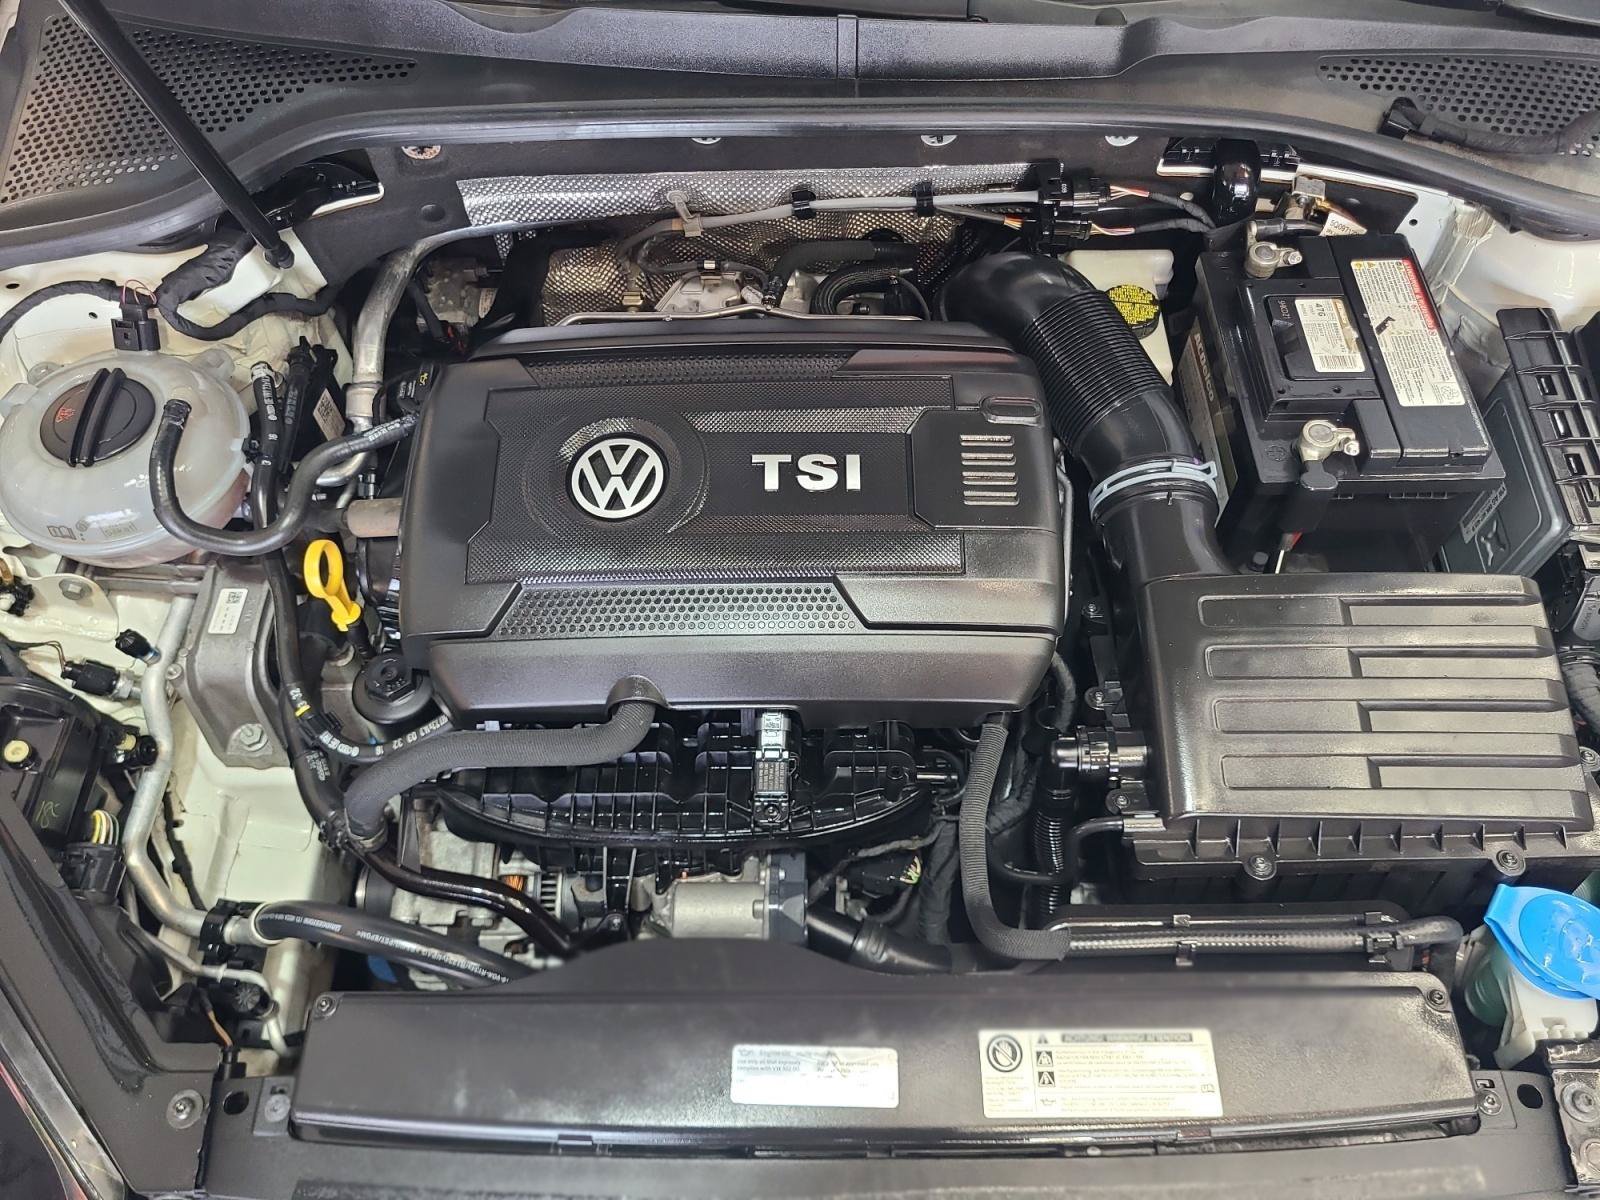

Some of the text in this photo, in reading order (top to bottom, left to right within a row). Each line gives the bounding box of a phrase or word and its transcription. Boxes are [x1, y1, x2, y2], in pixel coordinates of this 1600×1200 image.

[1315, 303, 1326, 317] 47G
[1192, 331, 1215, 403] ACDelco
[751, 453, 862, 492] TSI
[289, 687, 303, 700] 32
[406, 731, 418, 743] 03
[392, 739, 404, 751] 32
